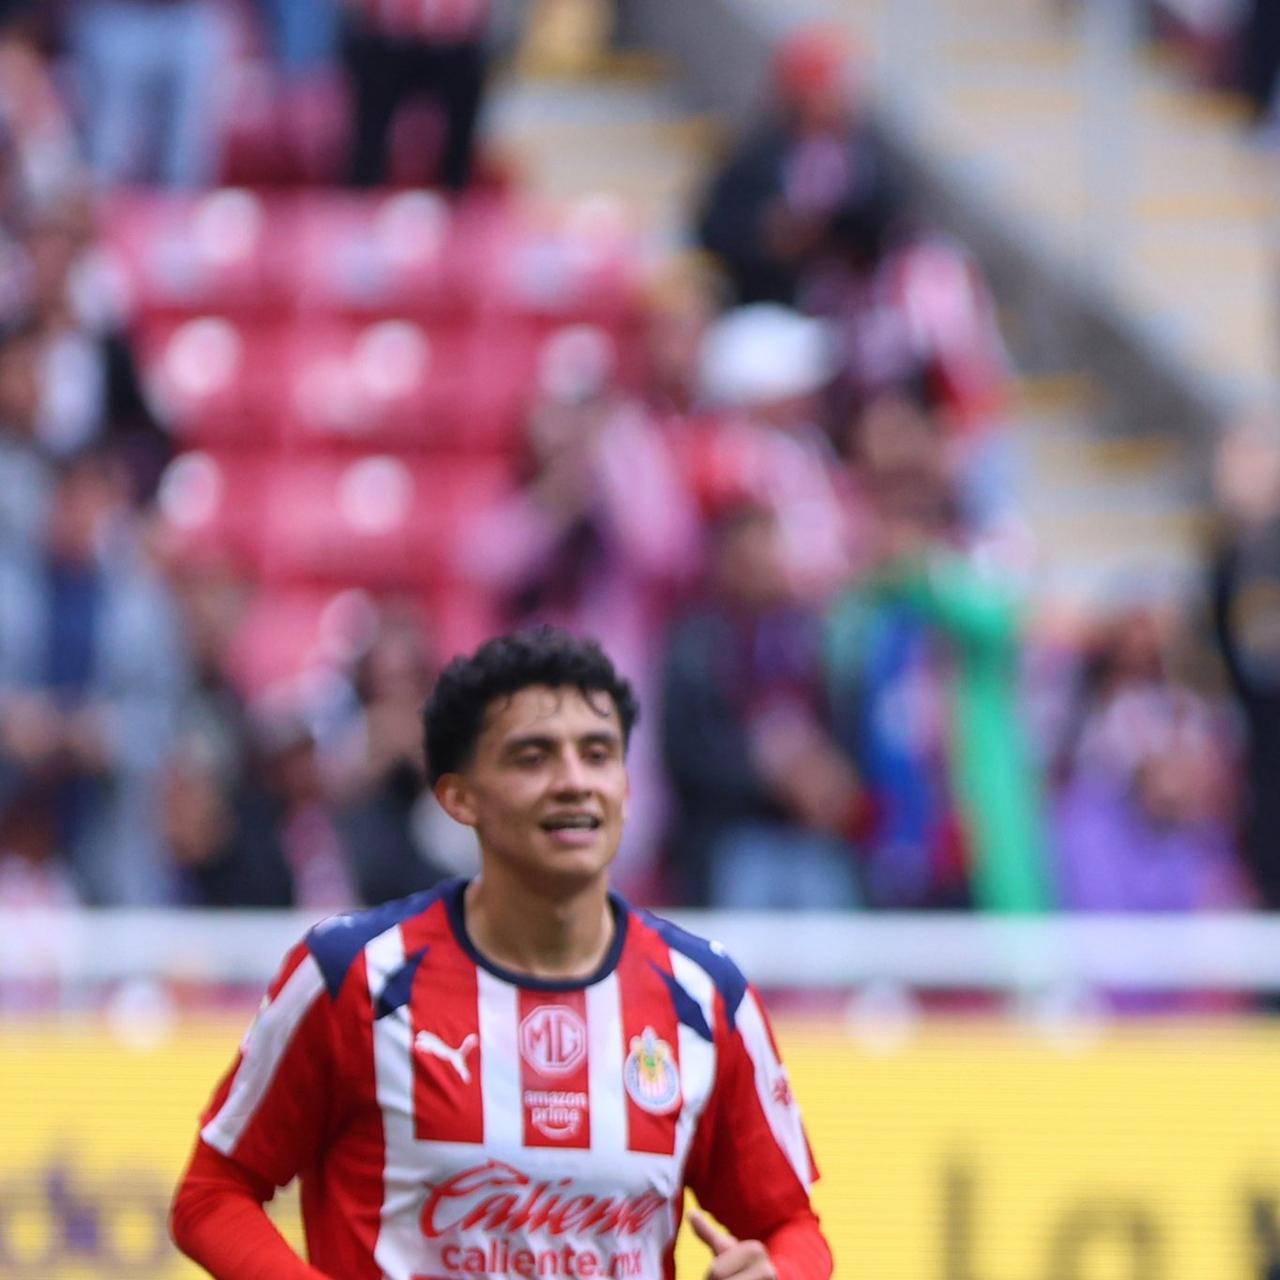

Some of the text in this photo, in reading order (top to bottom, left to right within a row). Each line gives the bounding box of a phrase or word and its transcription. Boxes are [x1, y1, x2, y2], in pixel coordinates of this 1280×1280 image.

[529, 1020, 579, 1066] MG
[524, 1089, 587, 1107] amazon
[531, 1104, 580, 1125] prime
